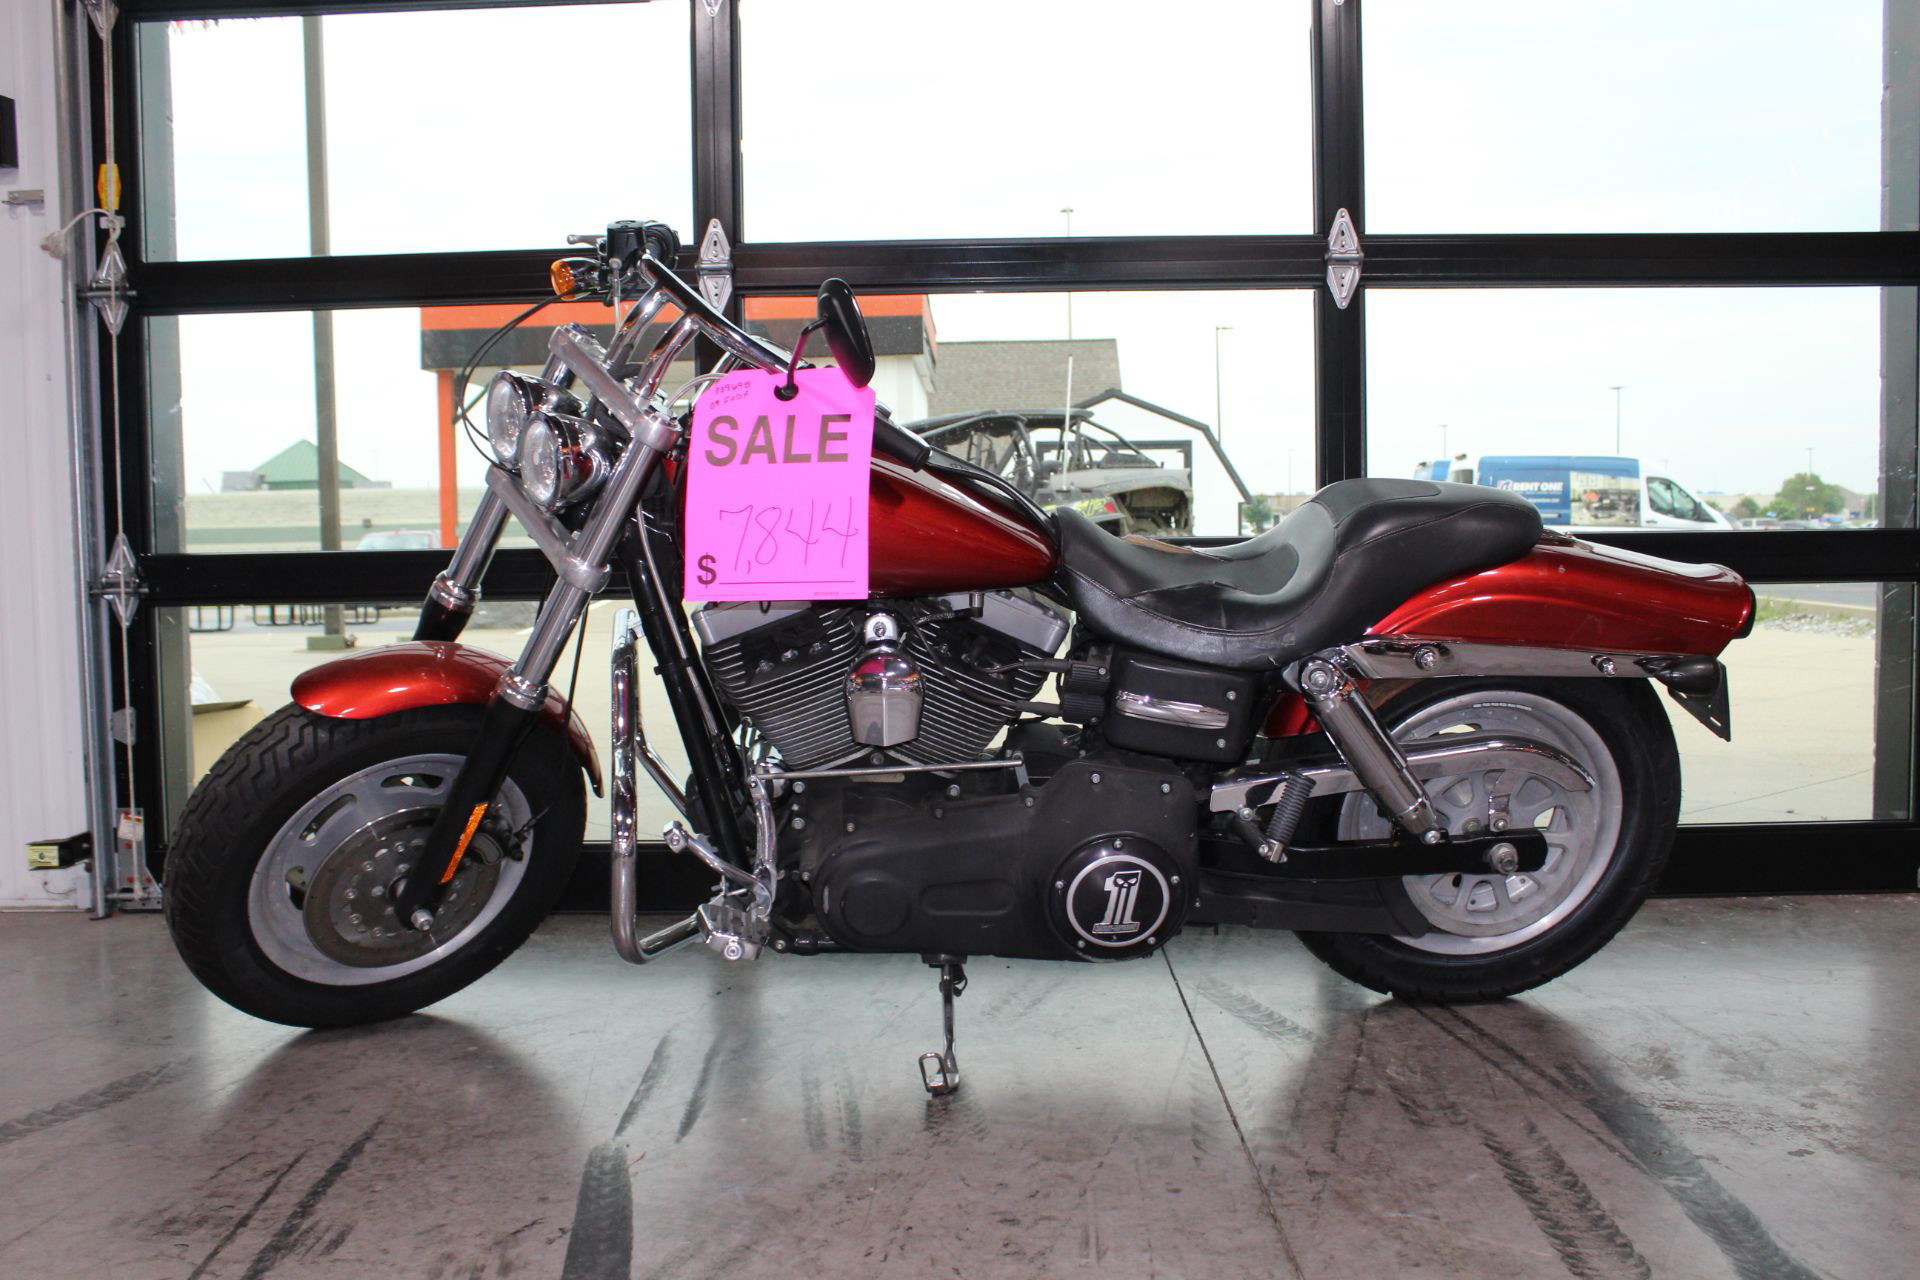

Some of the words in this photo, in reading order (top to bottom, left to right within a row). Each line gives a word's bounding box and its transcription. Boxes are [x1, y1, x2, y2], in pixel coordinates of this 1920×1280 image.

[705, 413, 852, 467] SALE
[1512, 481, 1541, 491] RENT
[696, 552, 717, 589] $
[719, 496, 859, 575] 7,844
